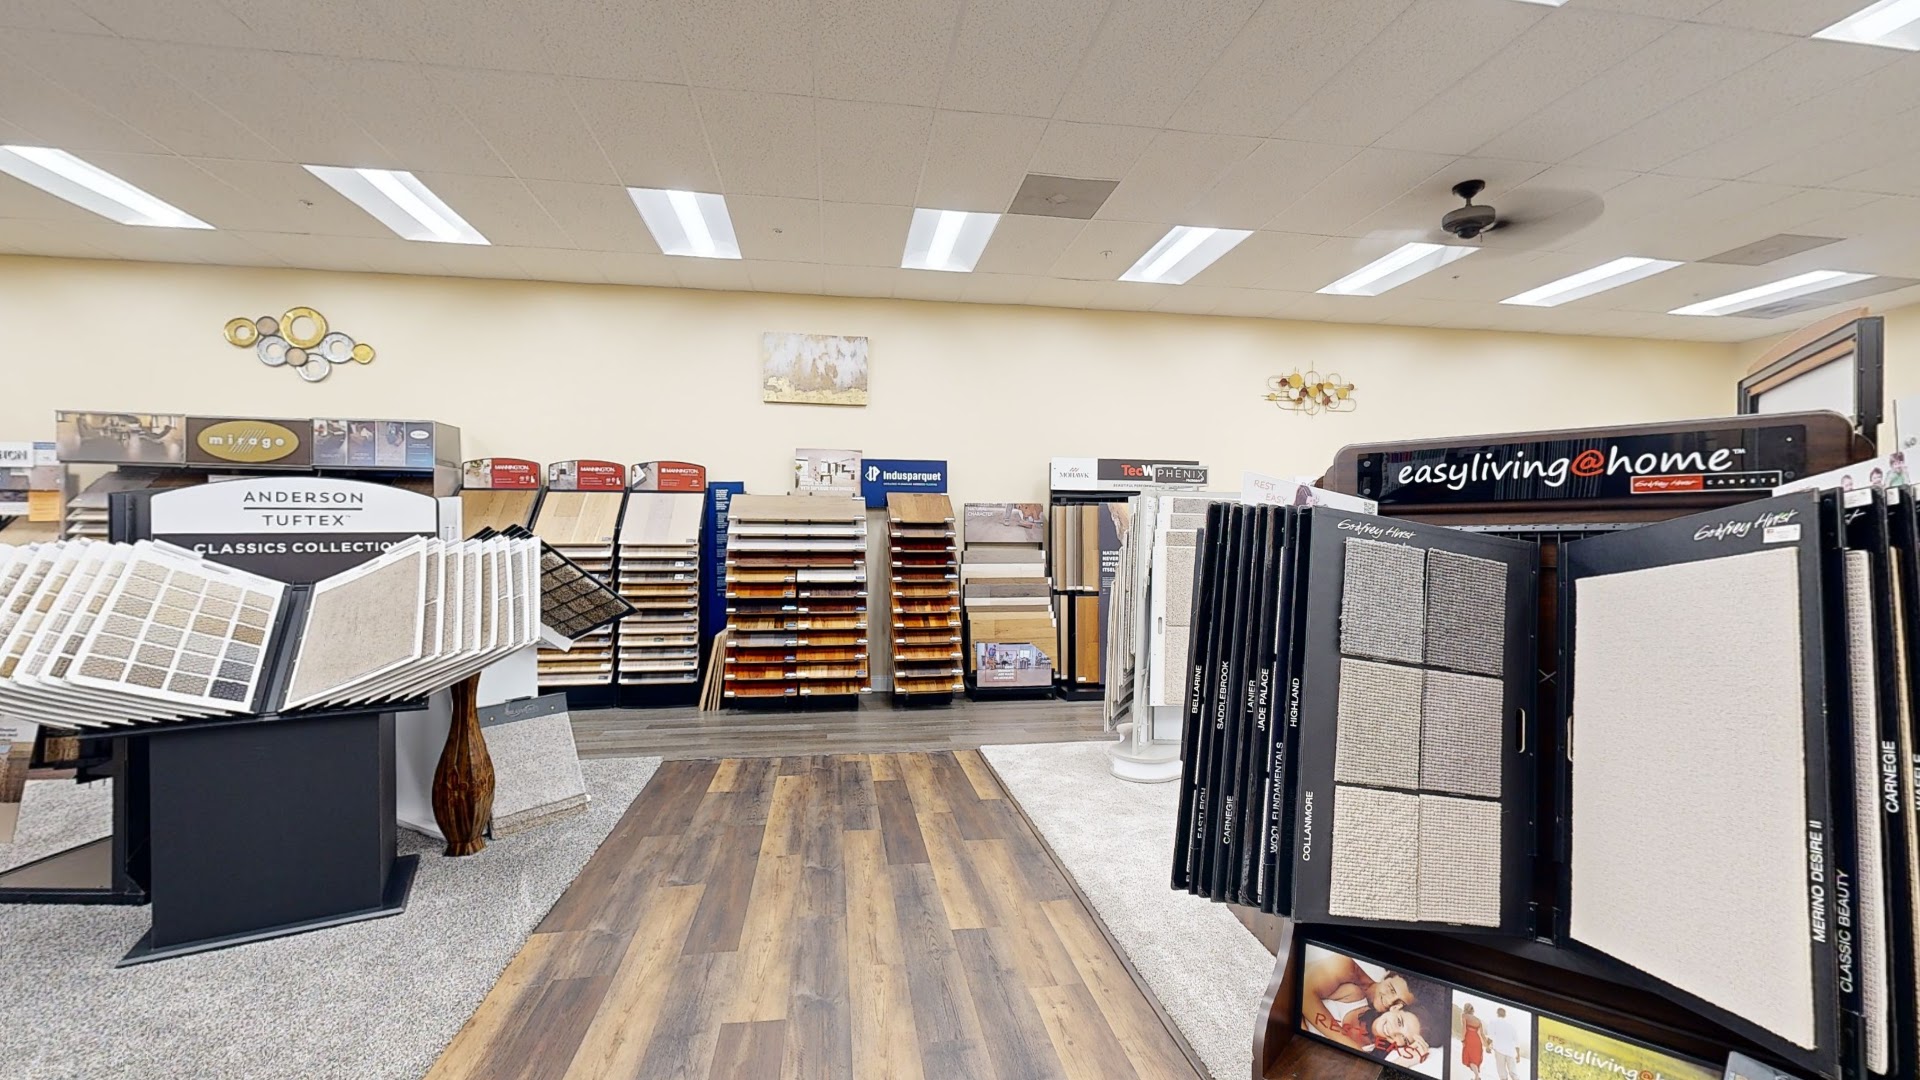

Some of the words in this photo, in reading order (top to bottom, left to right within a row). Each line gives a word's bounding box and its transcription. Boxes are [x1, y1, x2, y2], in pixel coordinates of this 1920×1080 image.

[208, 433, 285, 449] mirage
[883, 470, 941, 482] Indusparquet
[1121, 464, 1153, 477] TecW
[1157, 469, 1205, 479] PHENIX
[1253, 479, 1276, 491] REST
[1706, 477, 1777, 486] CARPETS
[243, 491, 364, 503] ANDERSON
[1266, 493, 1287, 504] EASY
[193, 543, 287, 555] CLASSICS
[292, 541, 398, 553] COLLECTIO
[1191, 664, 1202, 714] BELLARINE
[1216, 661, 1229, 730] SADDLEBROOK
[1247, 680, 1256, 713] LANIER
[1259, 668, 1269, 705] PALACE
[1290, 678, 1300, 727] HIGHLAND
[1257, 707, 1267, 731] JADE
[1882, 740, 1900, 813] CARNEGIE
[1223, 795, 1234, 844] CARNEGIE
[1302, 791, 1313, 861] COLLANMORE
[1809, 820, 1823, 829] II
[1809, 830, 1824, 883] DESIRE
[1811, 885, 1826, 943] MERINO
[1835, 869, 1850, 926] BEAUTY
[1838, 927, 1853, 993] CLASSIC
[1314, 1012, 1368, 1042] REST
[1375, 1036, 1430, 1064] EASY
[1544, 1040, 1664, 1080] easyliving@
